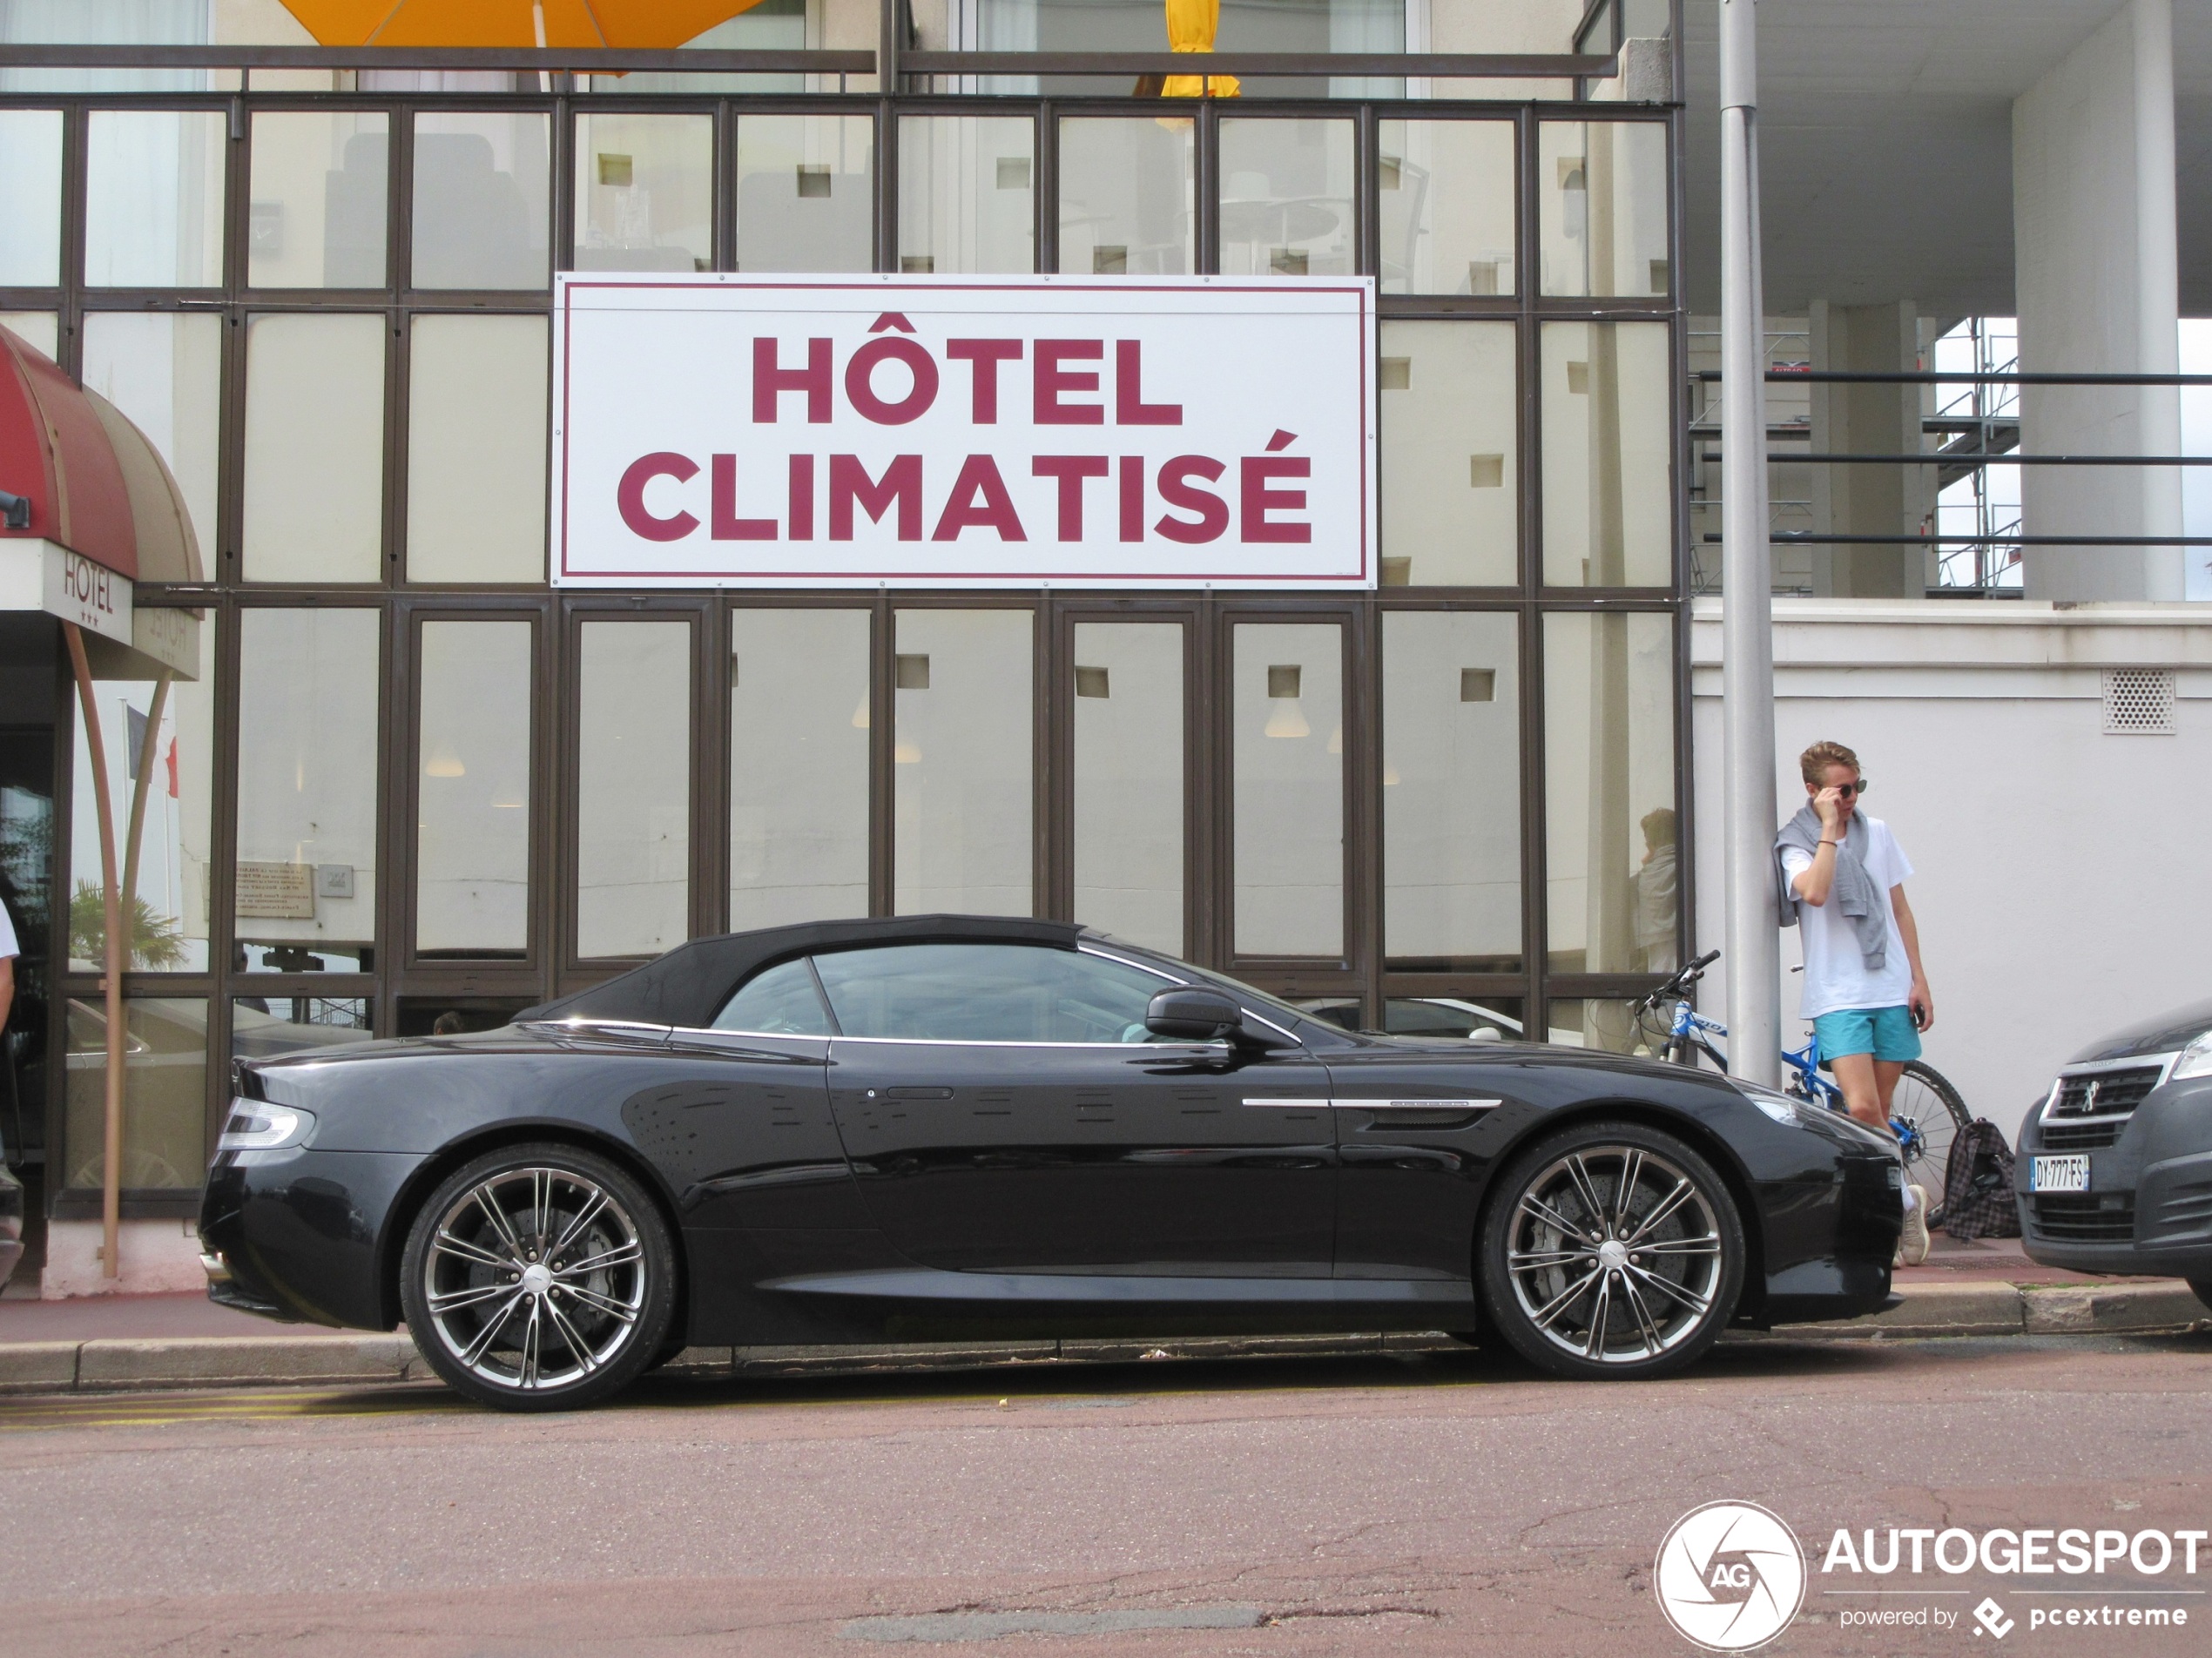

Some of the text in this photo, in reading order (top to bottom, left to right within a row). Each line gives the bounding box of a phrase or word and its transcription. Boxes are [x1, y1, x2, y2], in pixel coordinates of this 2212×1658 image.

[752, 312, 1183, 427] HÔTEL
[617, 429, 1312, 544] CLIMATISÉ
[64, 551, 114, 615] HOTEL
